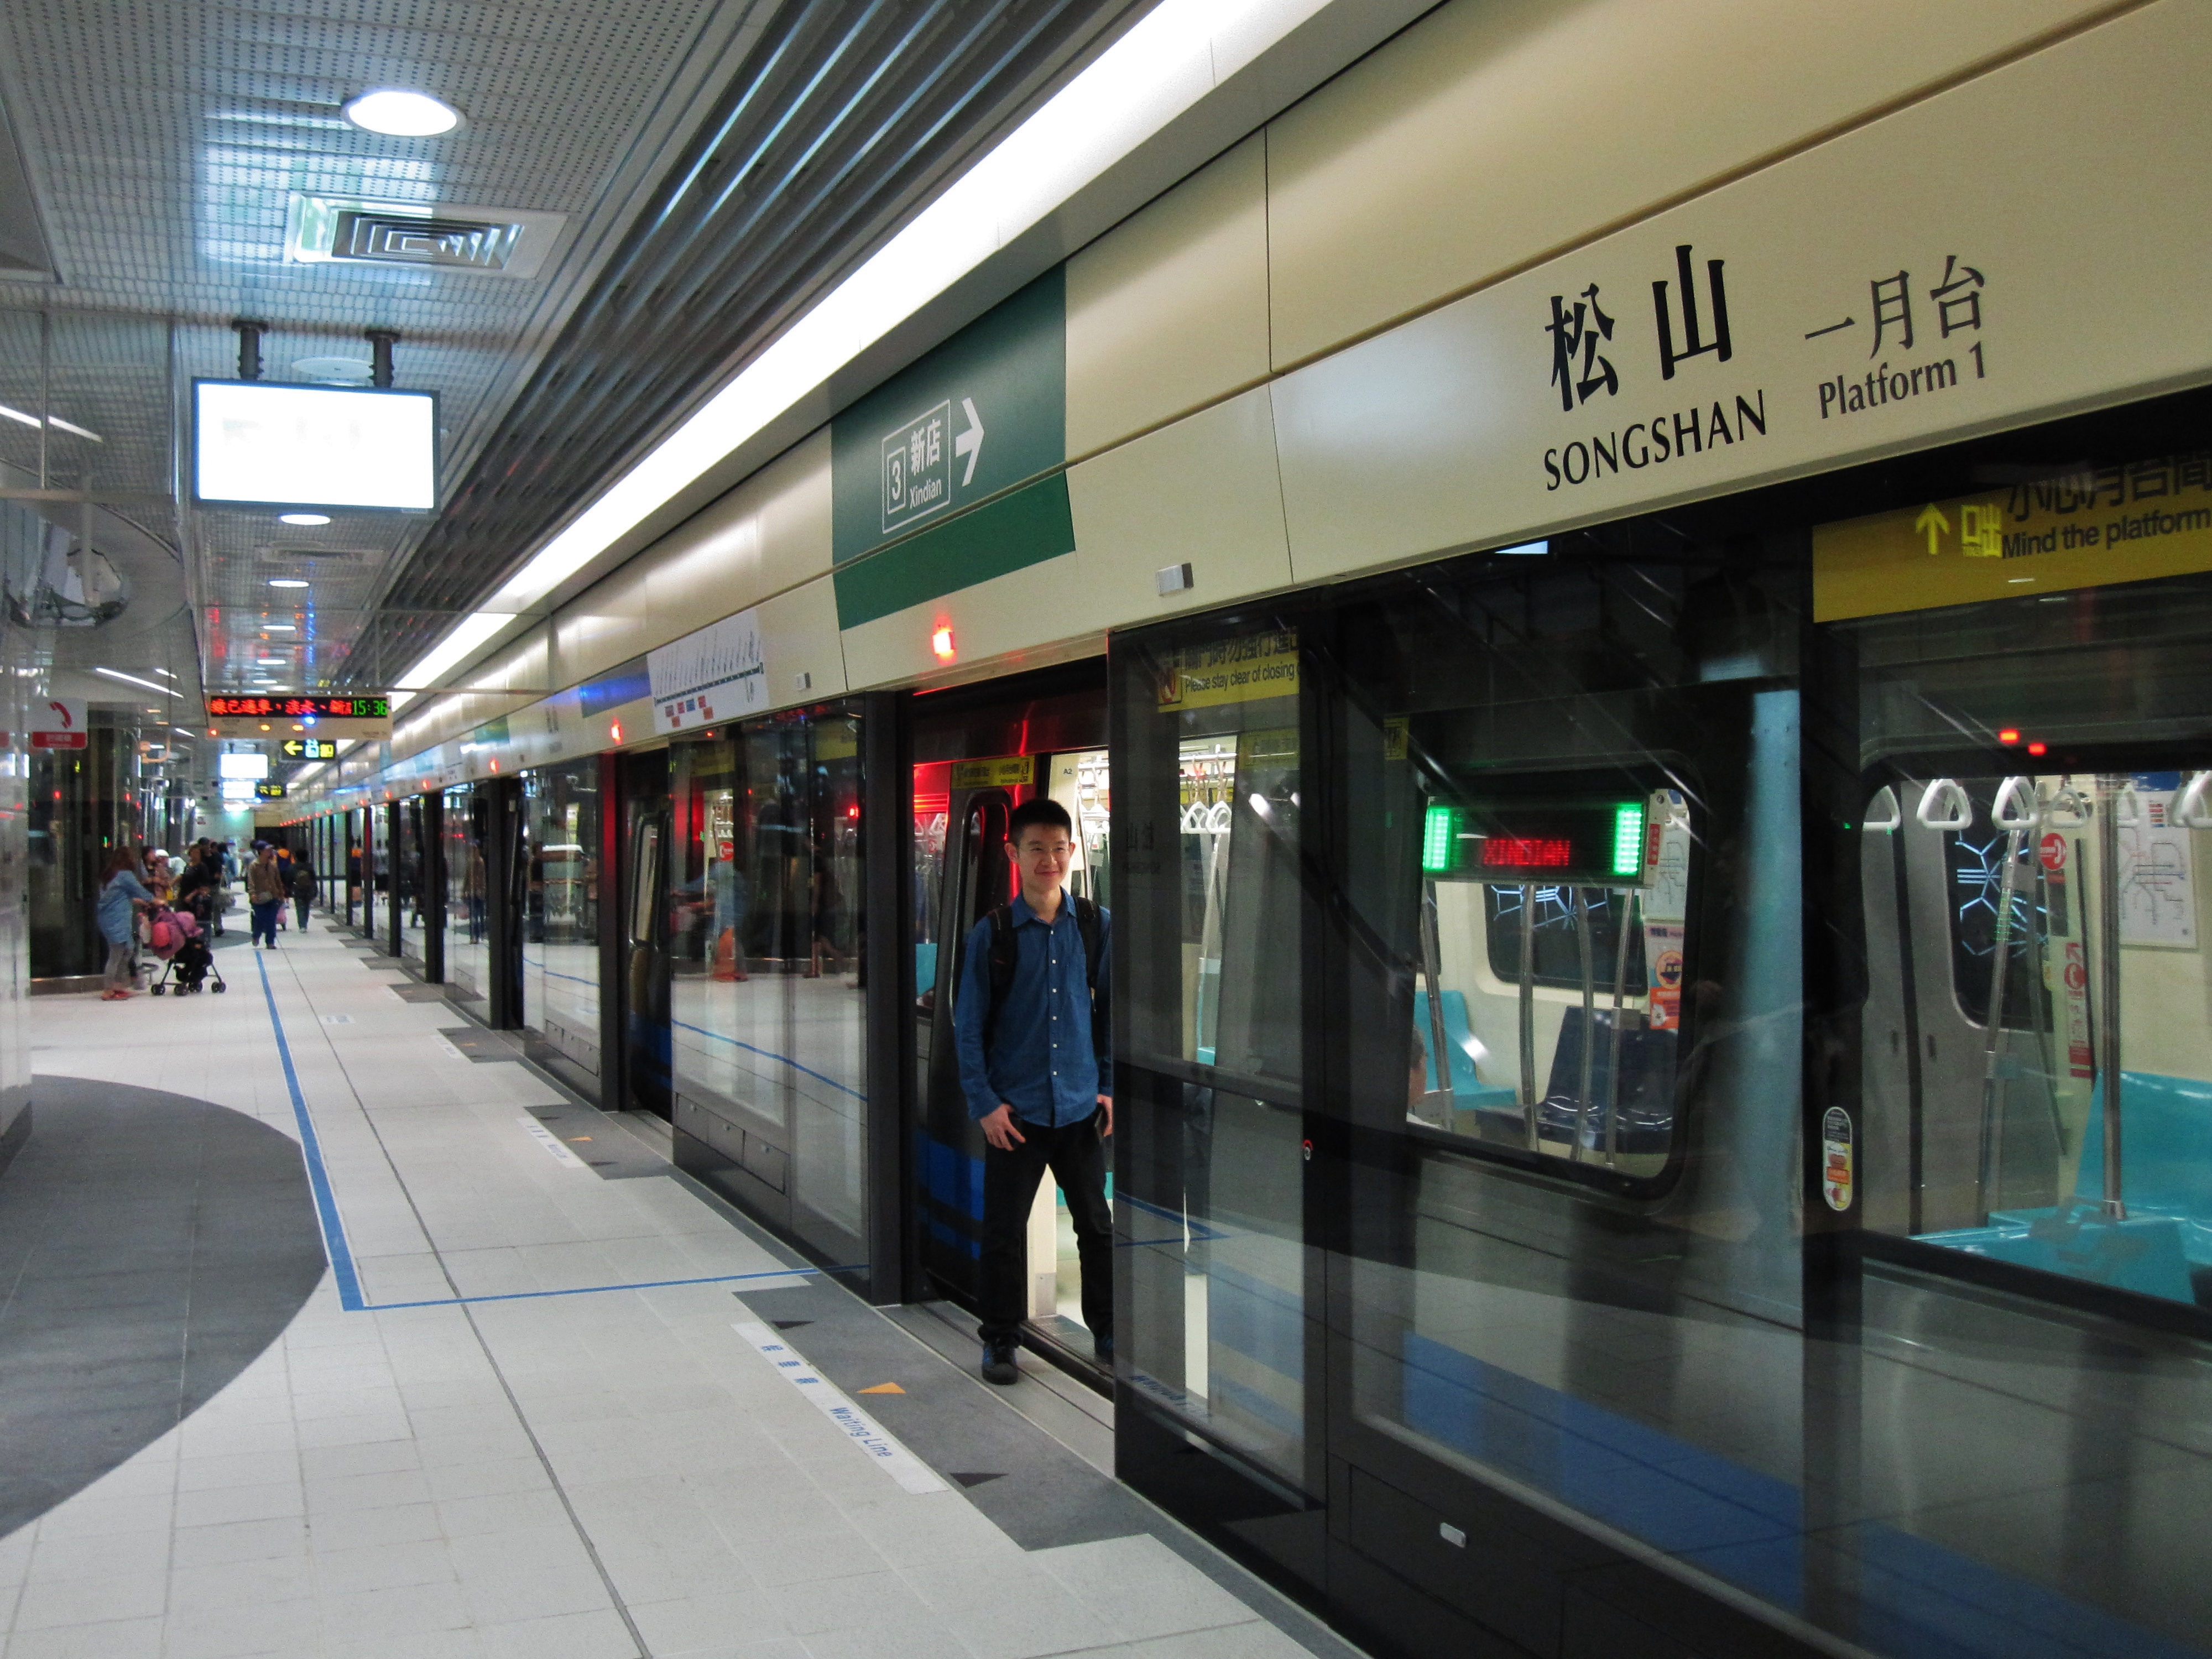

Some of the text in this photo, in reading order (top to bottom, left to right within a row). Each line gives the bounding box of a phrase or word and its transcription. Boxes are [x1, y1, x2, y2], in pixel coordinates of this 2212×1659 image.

[1545, 244, 1732, 412] 松山
[1804, 254, 1985, 359] 一月台
[1818, 341, 1986, 419] Platform 1
[910, 419, 941, 476] 新店
[1543, 389, 1767, 491] SONGSHAN
[891, 460, 901, 500] 3
[910, 478, 942, 509] Xindian
[2002, 506, 2212, 559] Mind the platform
[1185, 676, 1211, 693] Please
[1212, 672, 1228, 691] stay
[1230, 670, 1251, 686] clear
[1252, 664, 1262, 682] of
[1262, 661, 1295, 681] closing
[352, 700, 388, 716] 15:36
[830, 1407, 893, 1457] Waiting Line
